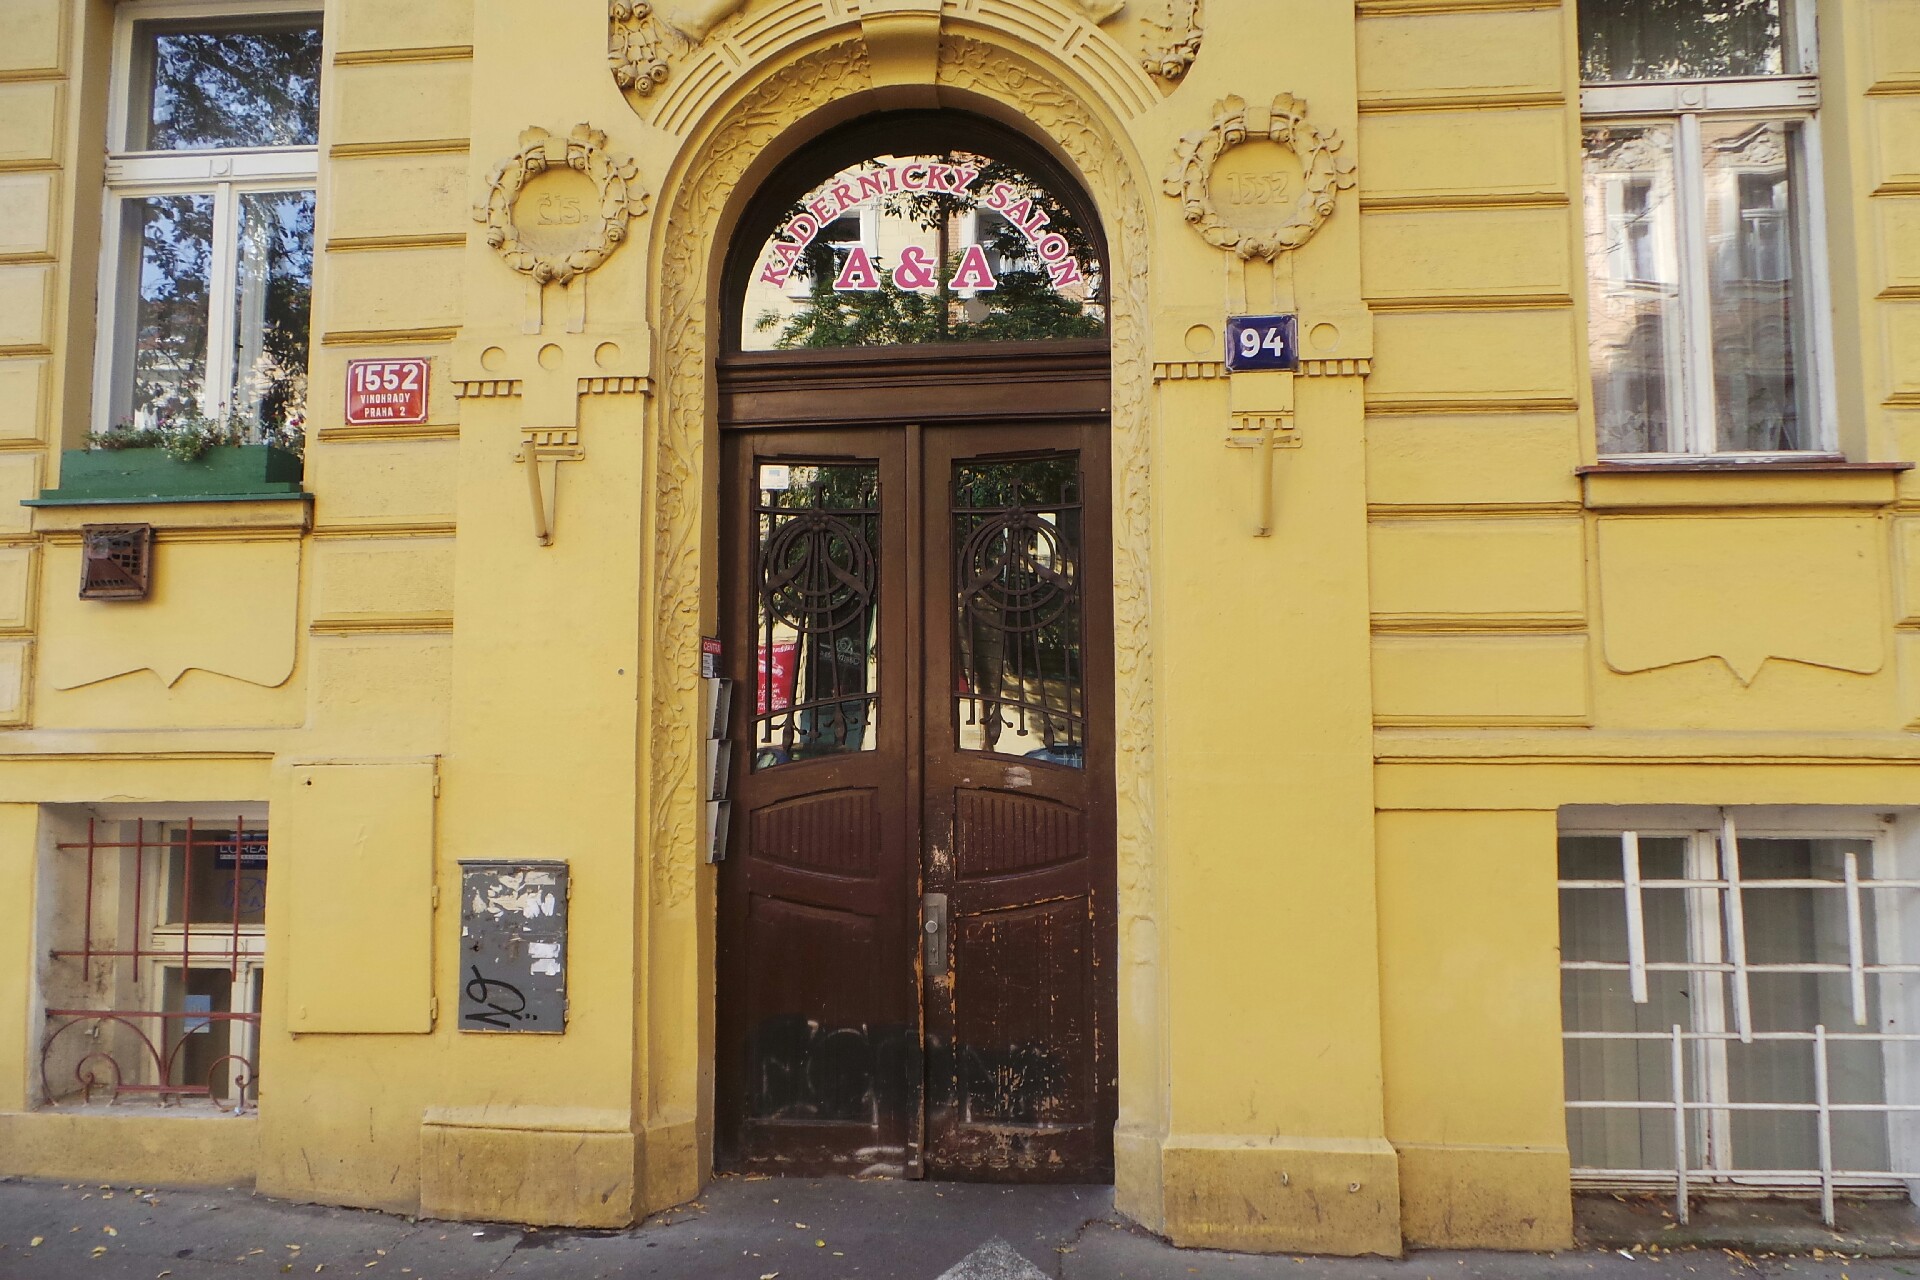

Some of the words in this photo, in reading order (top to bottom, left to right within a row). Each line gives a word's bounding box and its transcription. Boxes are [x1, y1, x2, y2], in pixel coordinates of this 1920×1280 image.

[1227, 171, 1289, 205] 1552
[760, 162, 979, 289] KADEŘNICKÝ
[986, 182, 1083, 290] SALON
[834, 246, 879, 291] A
[893, 245, 938, 291] &
[950, 244, 997, 291] A
[1240, 328, 1284, 358] 94
[355, 364, 419, 392] 1552
[360, 393, 411, 404] VINOHRADY
[364, 407, 393, 417] PRAHA
[399, 406, 406, 416] 2
